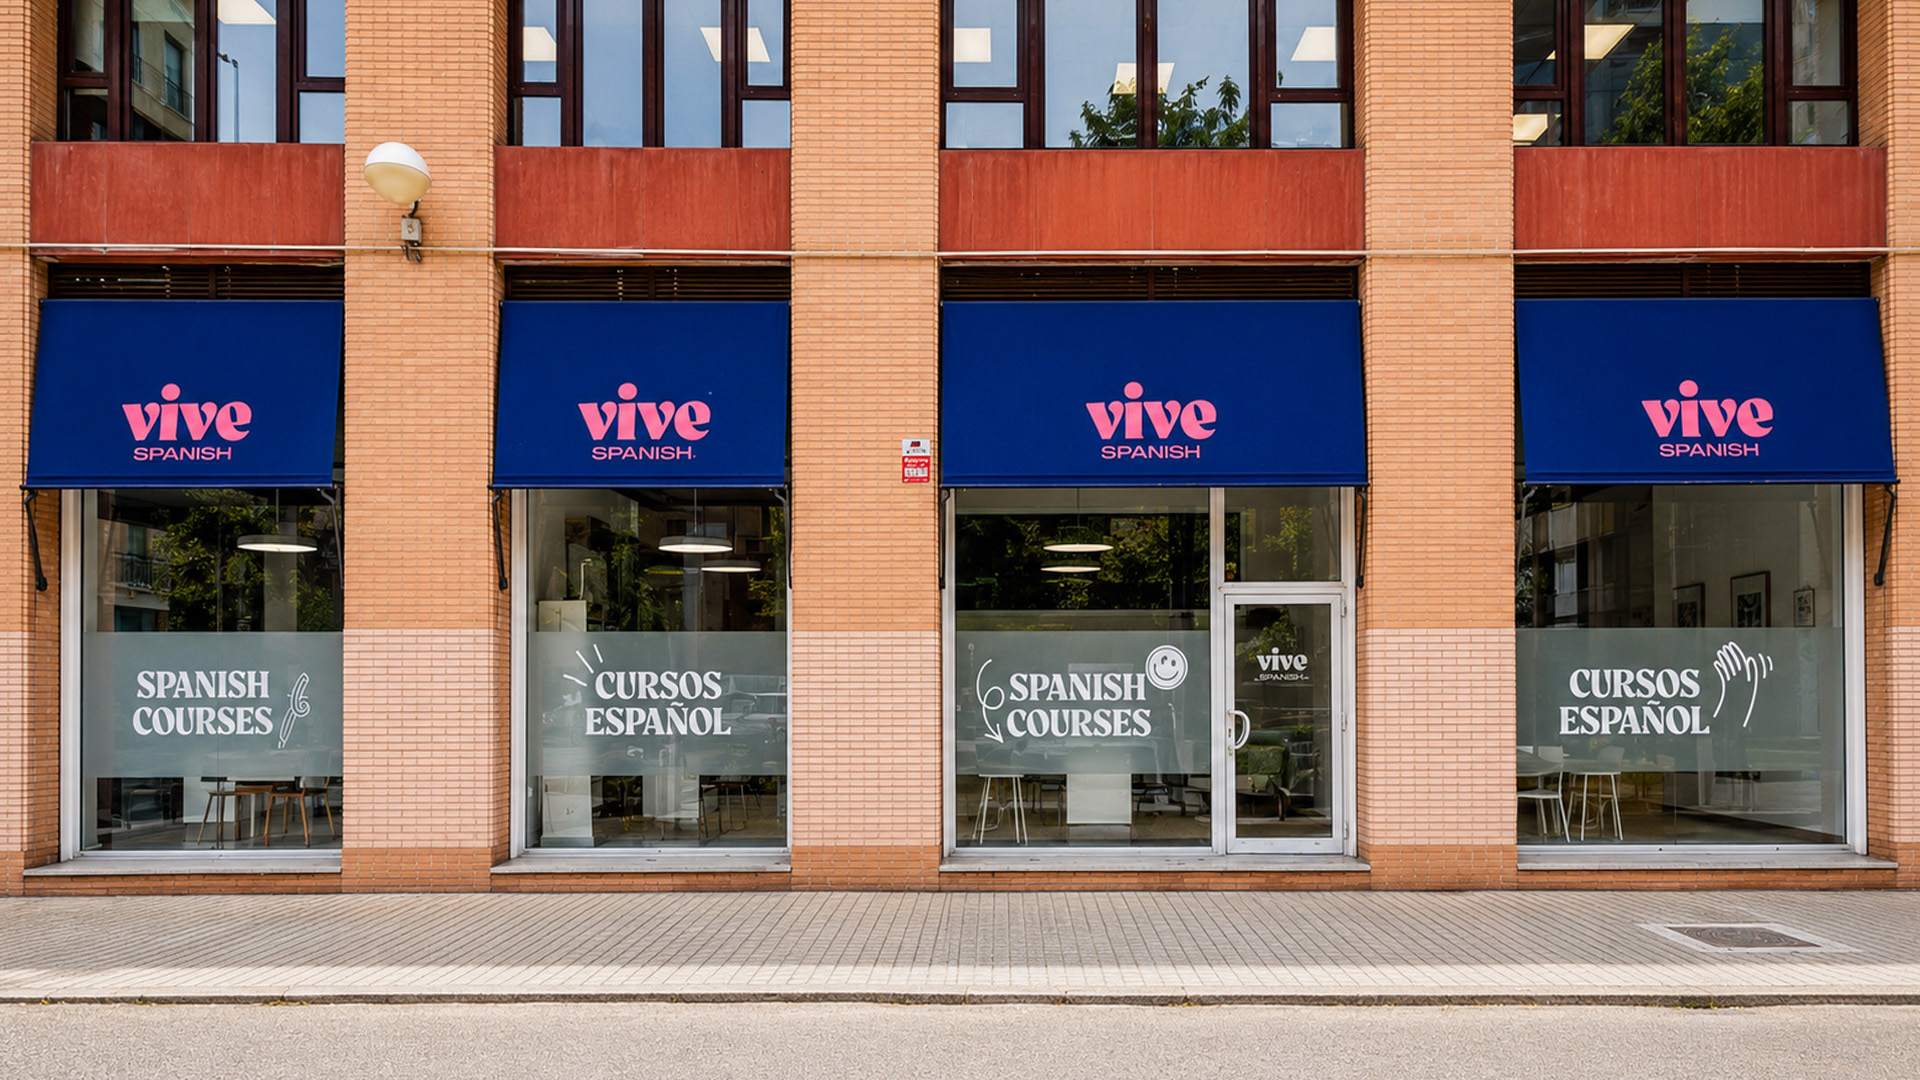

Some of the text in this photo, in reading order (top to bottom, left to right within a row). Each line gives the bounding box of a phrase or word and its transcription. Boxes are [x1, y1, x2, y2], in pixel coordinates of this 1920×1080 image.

[122, 384, 251, 441] vive
[578, 383, 710, 440] vive
[1086, 382, 1216, 439] vive
[1642, 380, 1773, 437] vive
[133, 446, 232, 461] SPANISH
[1101, 445, 1200, 459] SPANISH
[1660, 443, 1759, 457] SPANISH
[1256, 647, 1308, 671] vive
[137, 670, 270, 699] SPANISH
[595, 671, 722, 700] CURSOS
[1009, 673, 1146, 701] SPANISH
[1569, 668, 1700, 699] CURSOS
[132, 706, 273, 736] COURSES
[585, 702, 731, 735] ESPAÑOL
[1006, 708, 1152, 738] COURSES
[1559, 700, 1710, 735] ESPAÑOL
